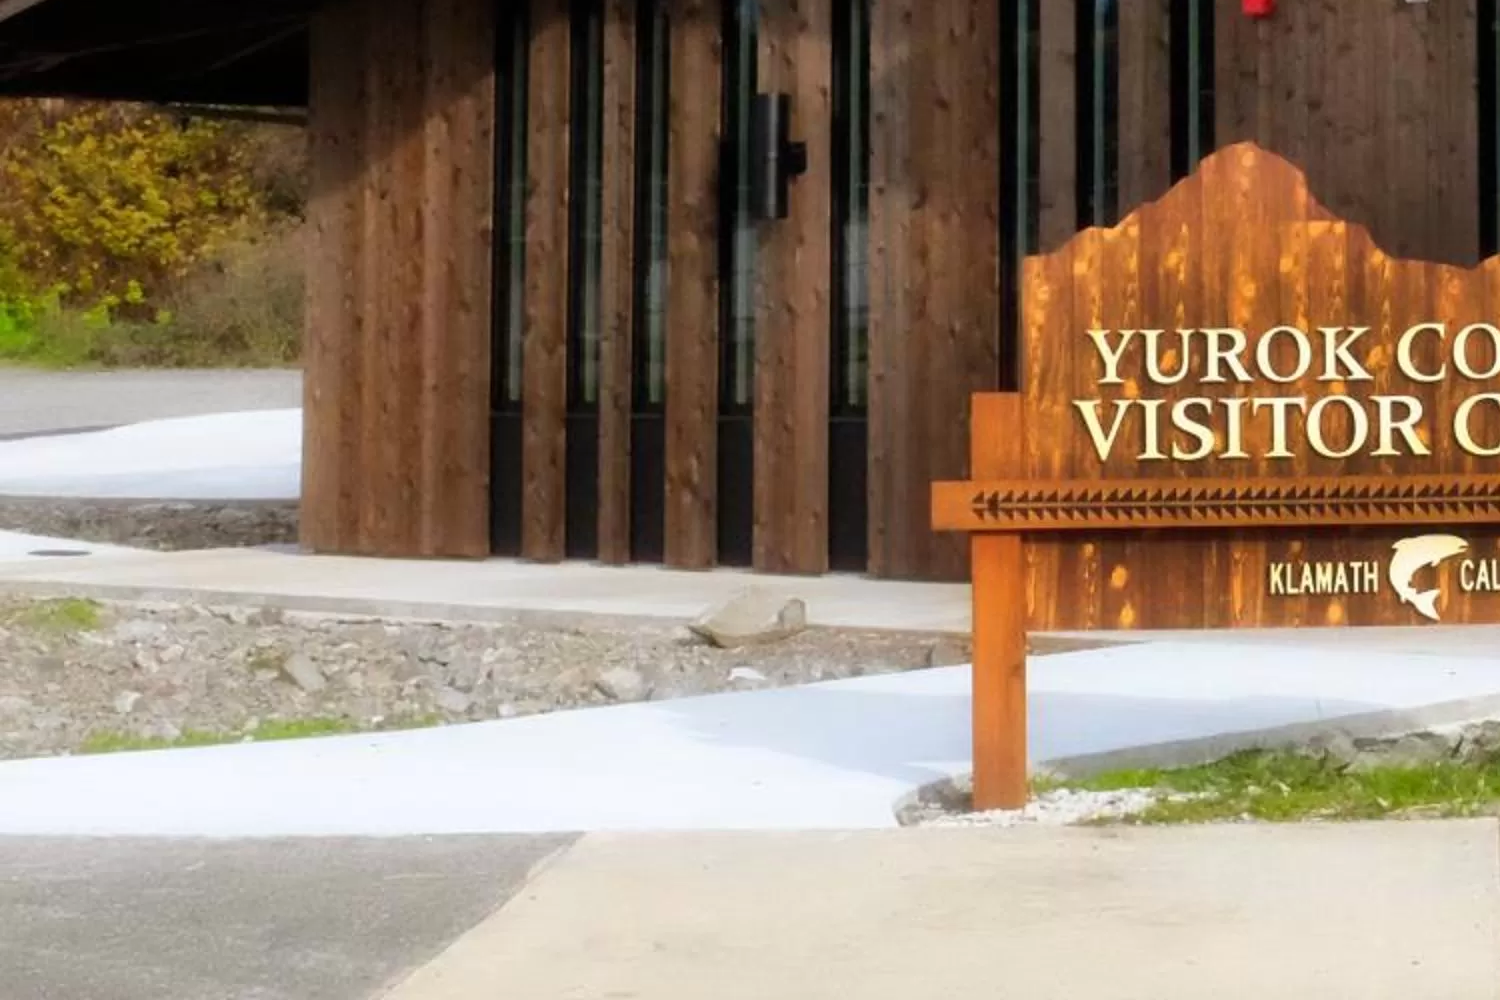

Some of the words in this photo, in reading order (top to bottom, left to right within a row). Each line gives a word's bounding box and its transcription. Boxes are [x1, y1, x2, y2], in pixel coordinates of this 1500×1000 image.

[1087, 327, 1374, 385] YUROK
[1073, 394, 1431, 461] VISITOR
[1270, 561, 1379, 594] KLAMATH
